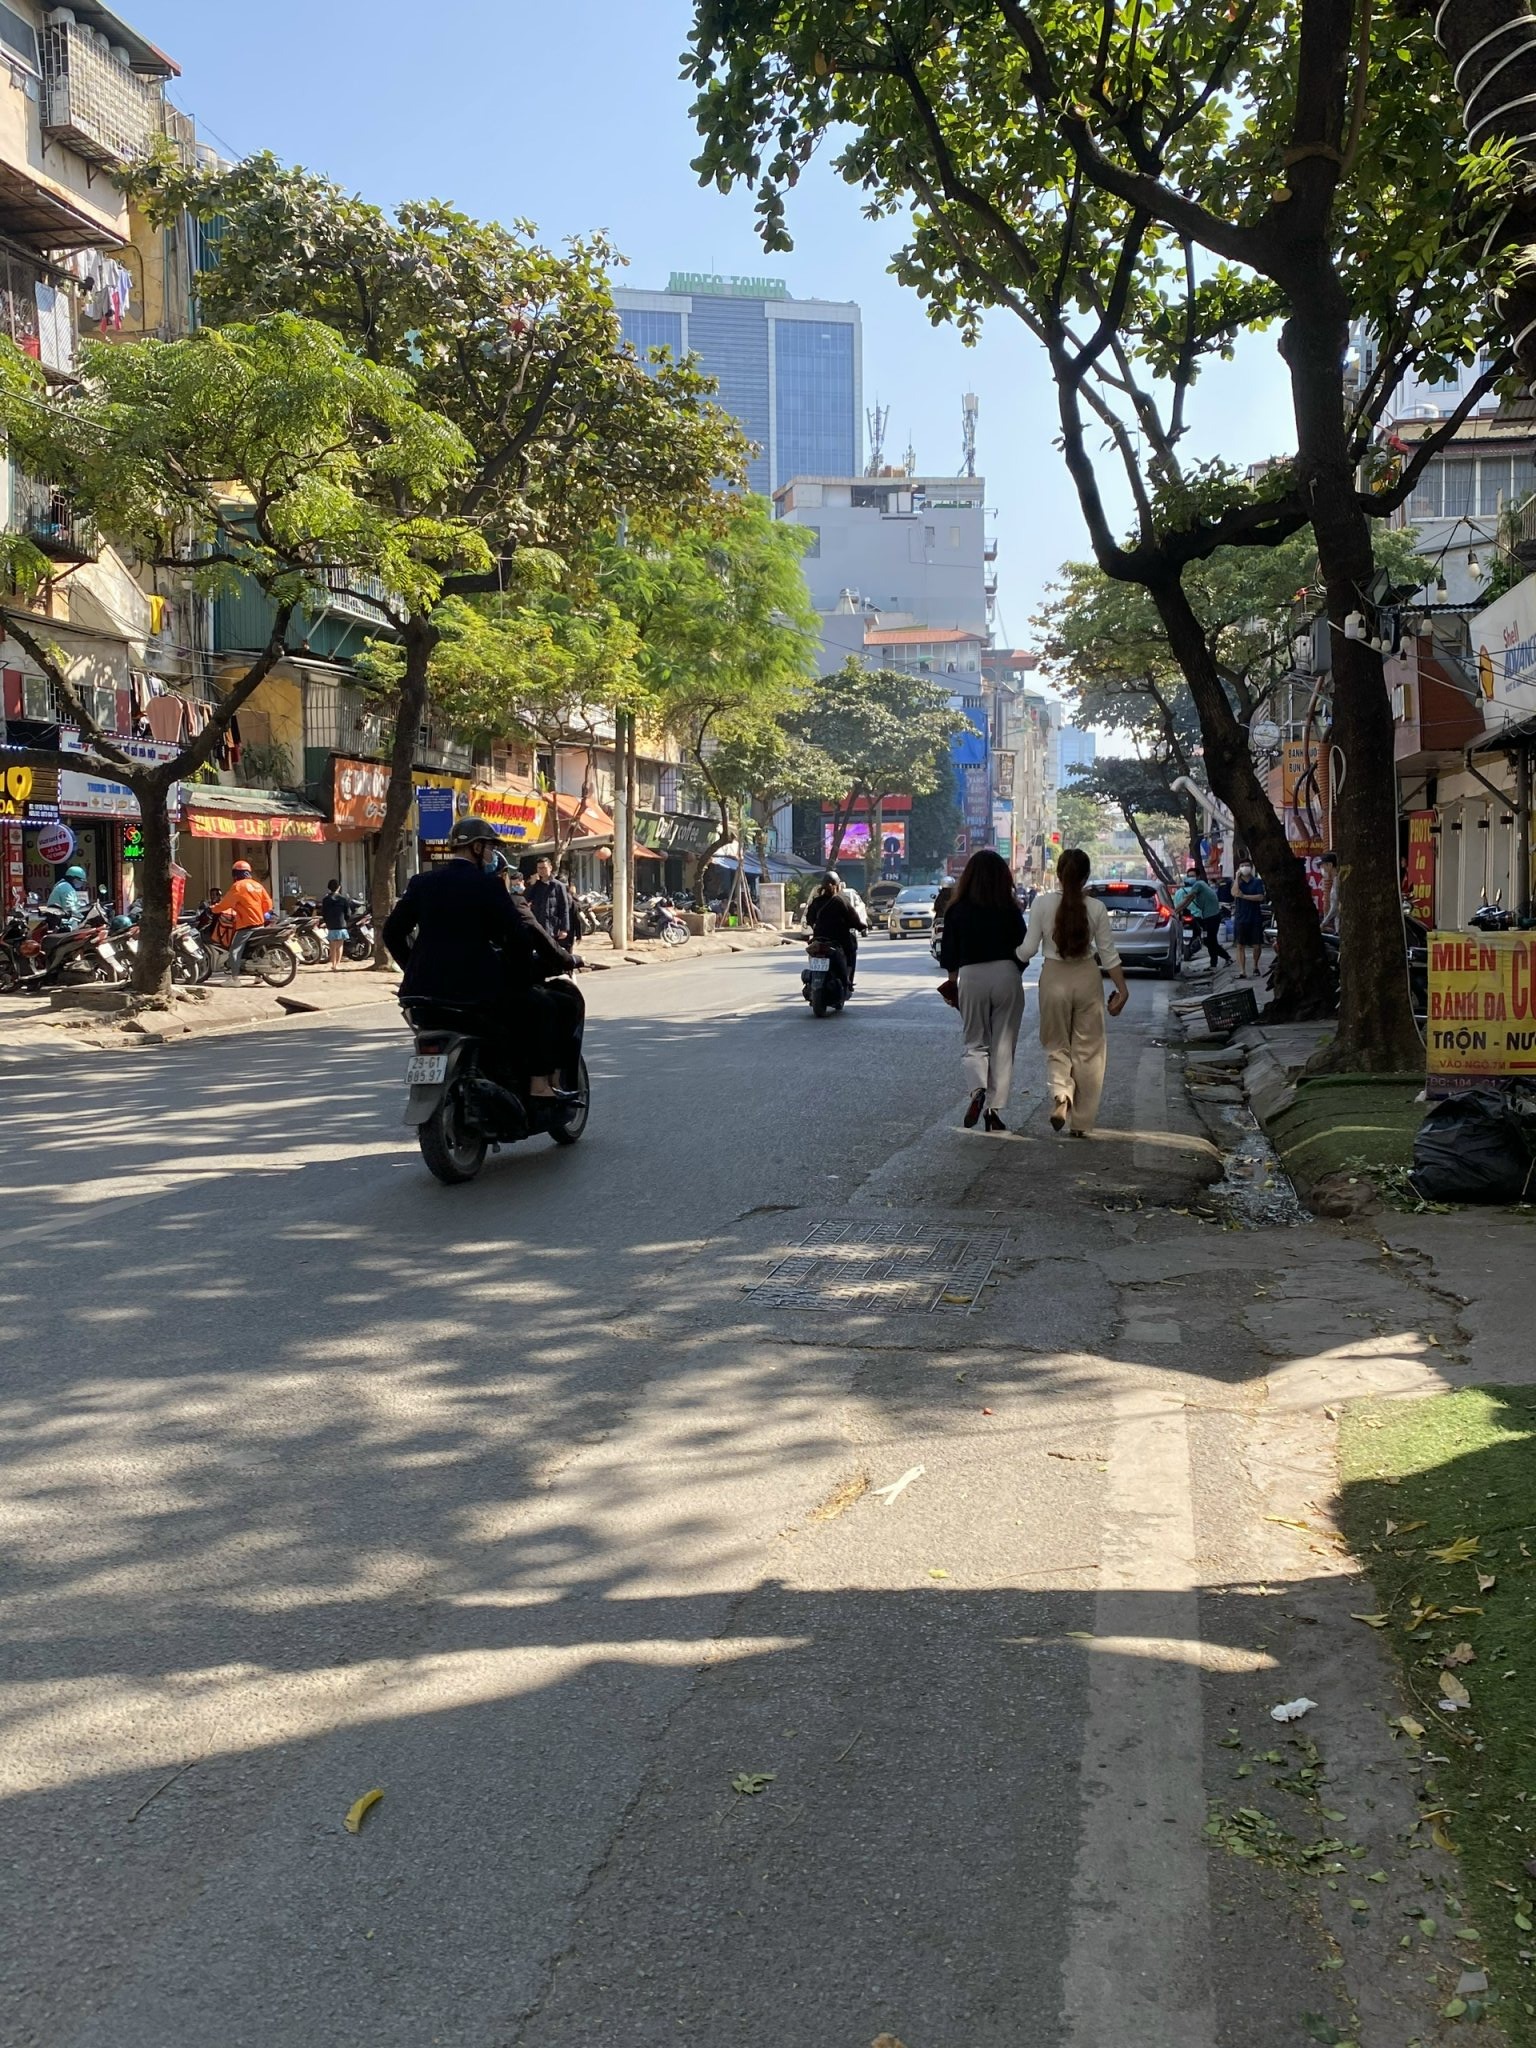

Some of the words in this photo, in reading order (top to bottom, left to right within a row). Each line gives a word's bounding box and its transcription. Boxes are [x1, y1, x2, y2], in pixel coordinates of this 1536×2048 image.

[731, 276, 786, 300] TOWER
[1503, 619, 1519, 648] Shell
[1432, 986, 1478, 1021] BÁNH
[1484, 992, 1507, 1021] ĐA
[1433, 1027, 1486, 1056] TRỘN
[1454, 1078, 1472, 1087] 104
